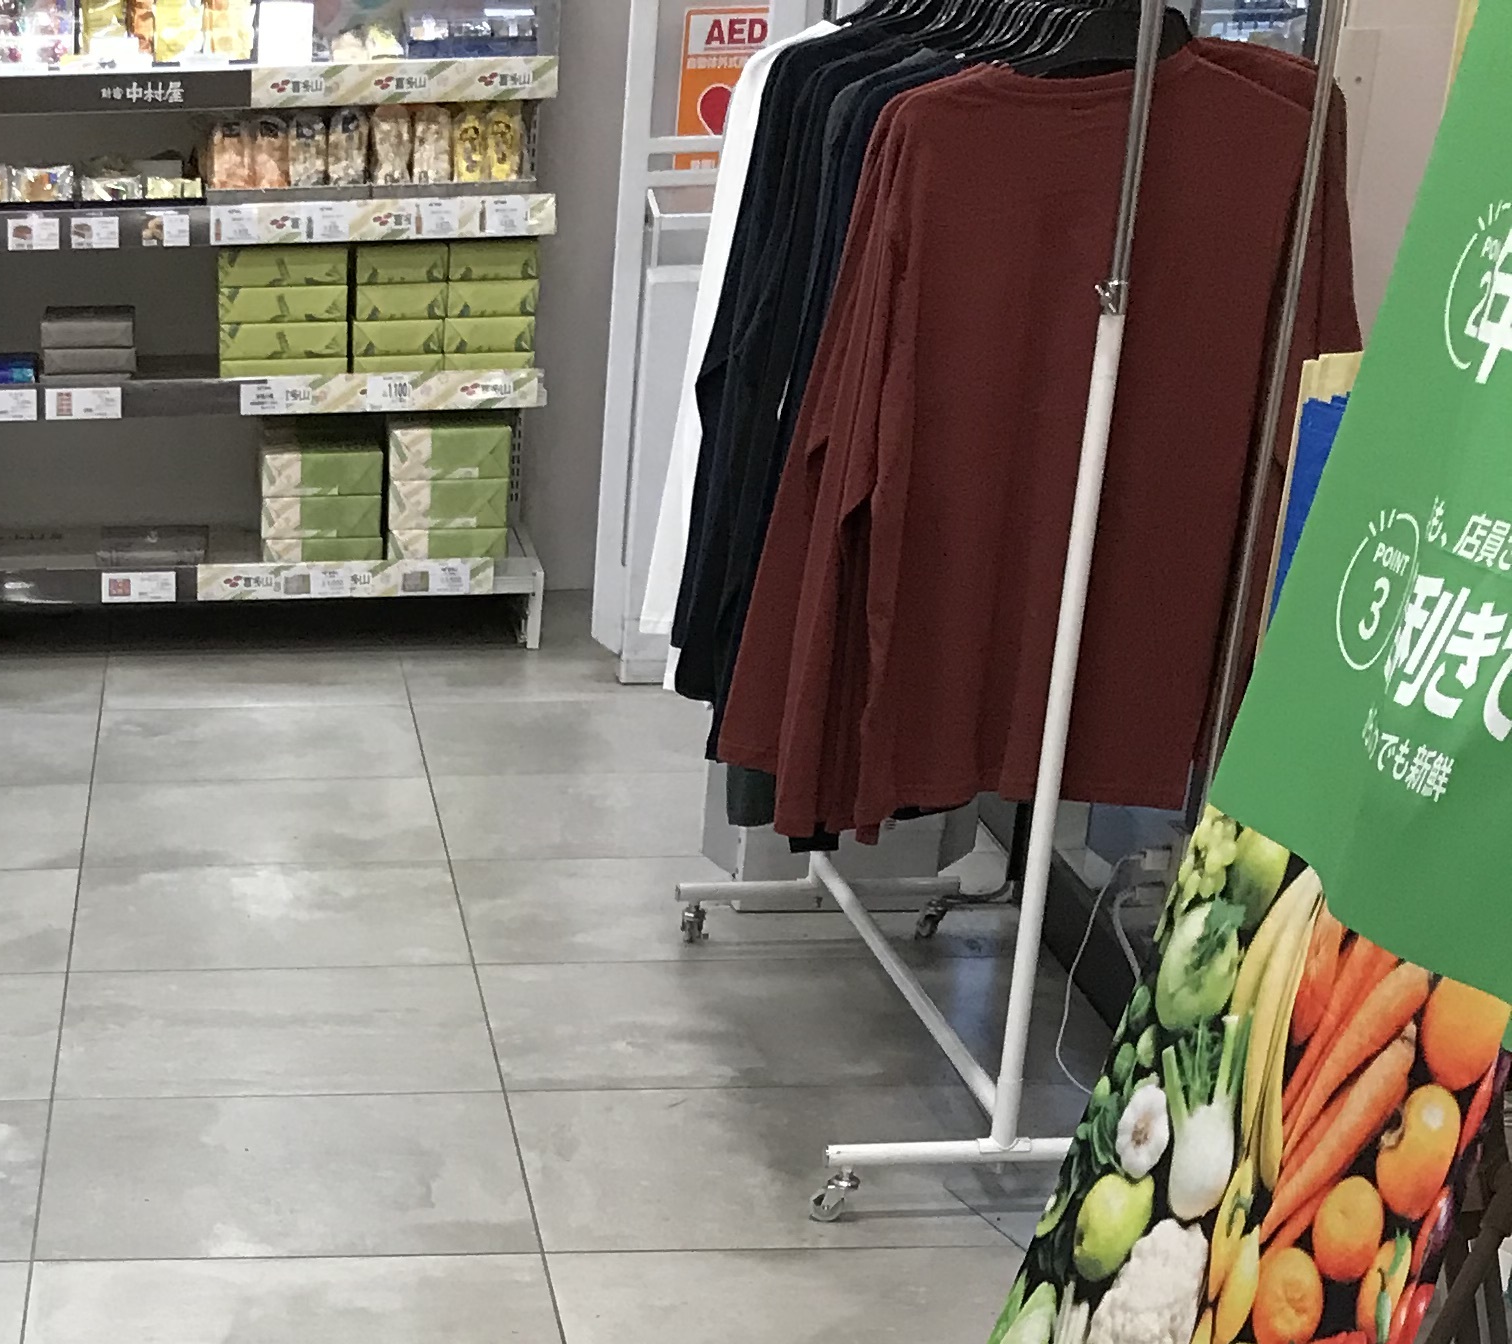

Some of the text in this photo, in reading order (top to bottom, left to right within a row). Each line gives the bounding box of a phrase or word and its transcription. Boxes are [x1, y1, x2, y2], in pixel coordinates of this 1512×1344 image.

[705, 18, 768, 45] AED
[1373, 542, 1410, 577] POINT
[1358, 576, 1390, 640] 3
